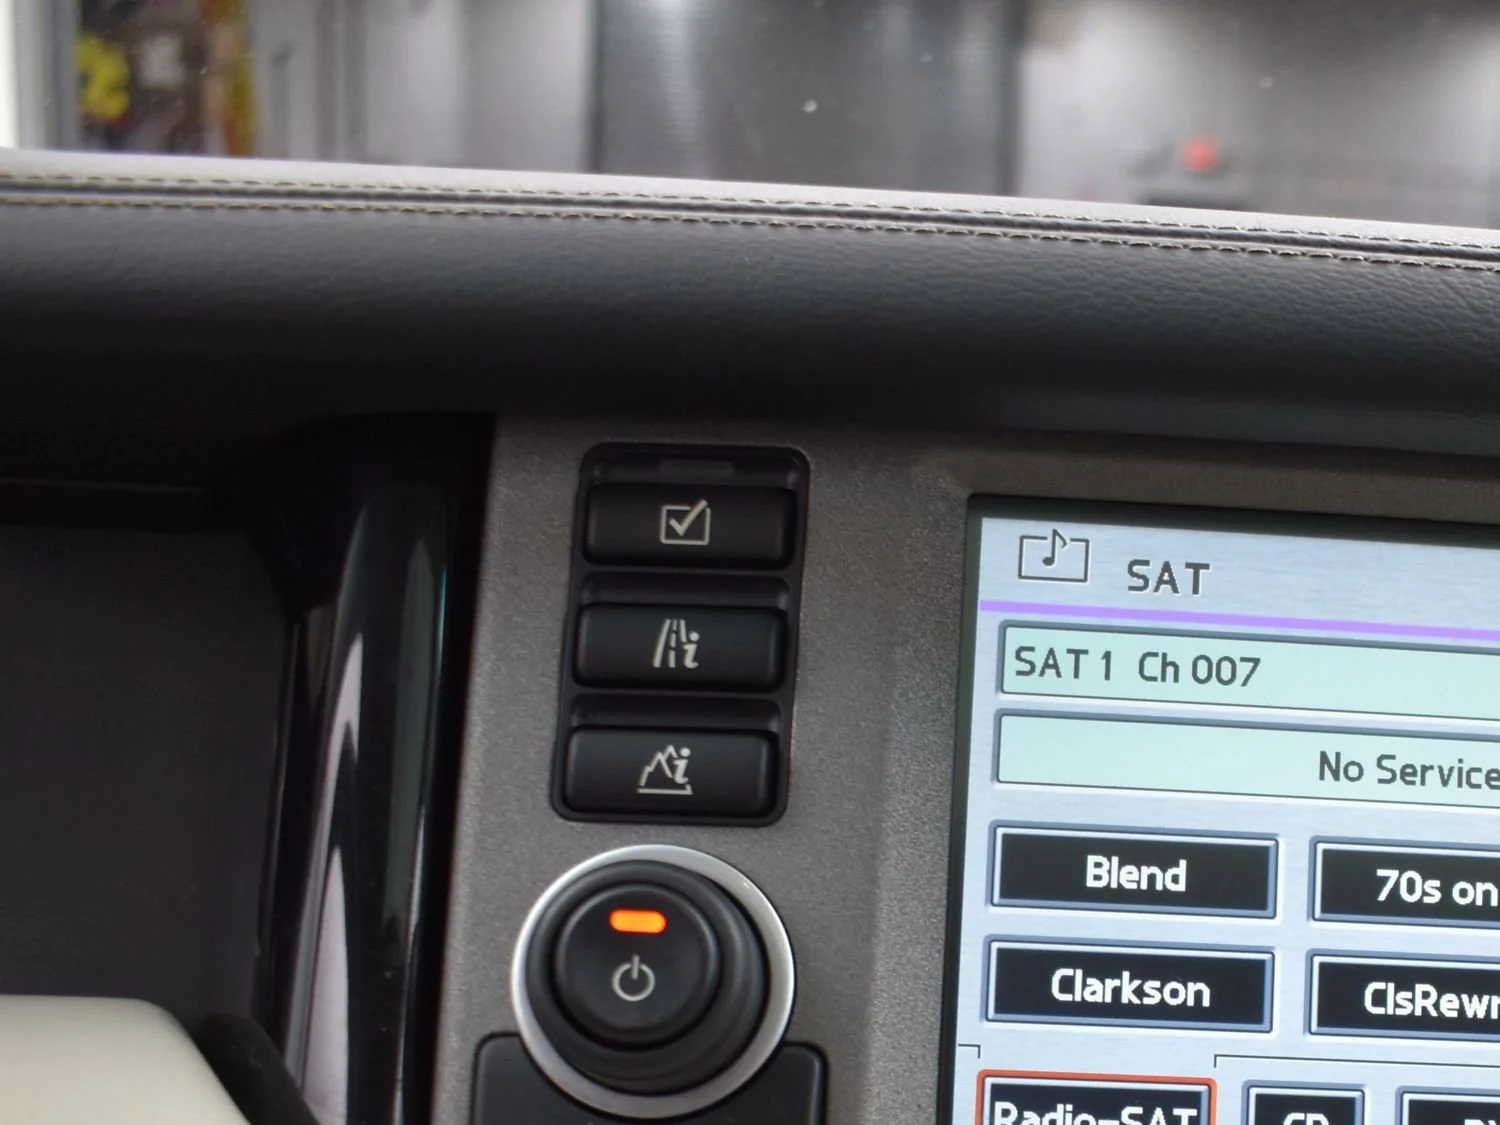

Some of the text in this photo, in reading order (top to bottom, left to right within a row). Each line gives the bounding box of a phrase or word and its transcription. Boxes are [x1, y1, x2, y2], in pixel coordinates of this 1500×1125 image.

[1127, 558, 1211, 596] SAT
[1138, 651, 1180, 683] Ch
[1191, 654, 1261, 687] 007
[1319, 750, 1364, 783] No
[1085, 855, 1187, 892] Blend
[1376, 869, 1442, 904] 70s
[1451, 881, 1499, 907] on
[1051, 968, 1211, 1007] Clarkson
